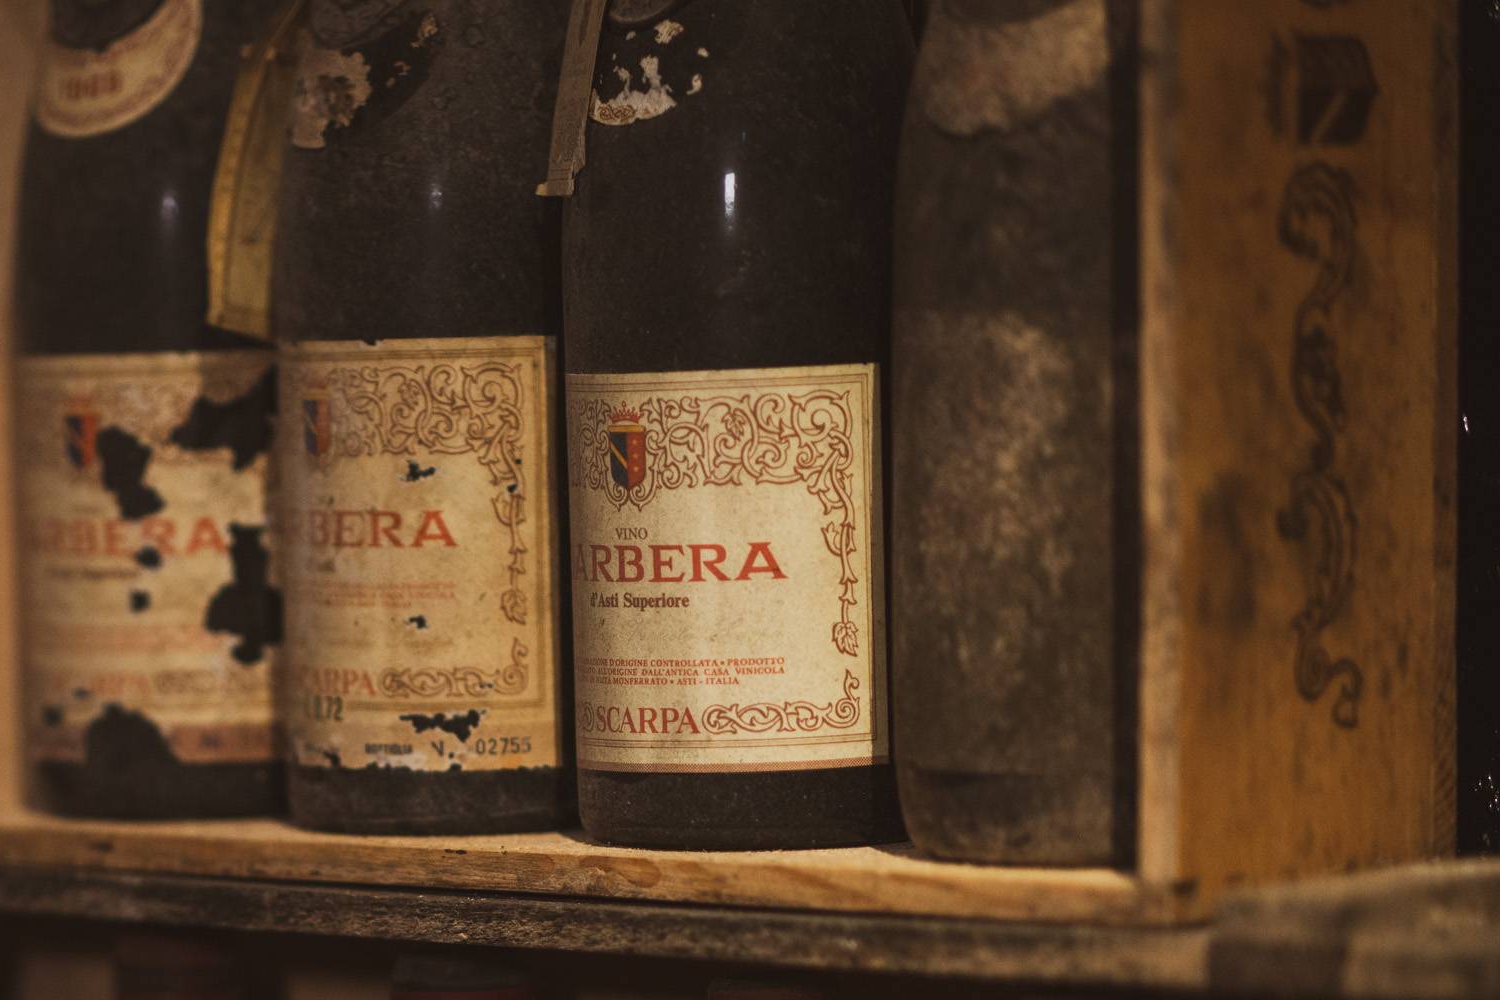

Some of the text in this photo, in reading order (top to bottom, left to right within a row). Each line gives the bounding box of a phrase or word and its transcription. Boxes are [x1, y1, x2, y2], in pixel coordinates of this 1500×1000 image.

[615, 527, 648, 540] VINO
[573, 541, 789, 583] ARBERA
[623, 592, 690, 612] Superiore
[650, 658, 718, 667] CONTROLLATA
[727, 657, 785, 667] PRODOTTO
[641, 668, 699, 677] DALL'ANTICA
[704, 668, 730, 677] CASA
[735, 666, 785, 675] VINICOLA
[612, 677, 668, 686] MONFERRATO
[676, 677, 697, 686] ASTI
[705, 676, 740, 686] ITALIA
[596, 705, 701, 735] SCARPA
